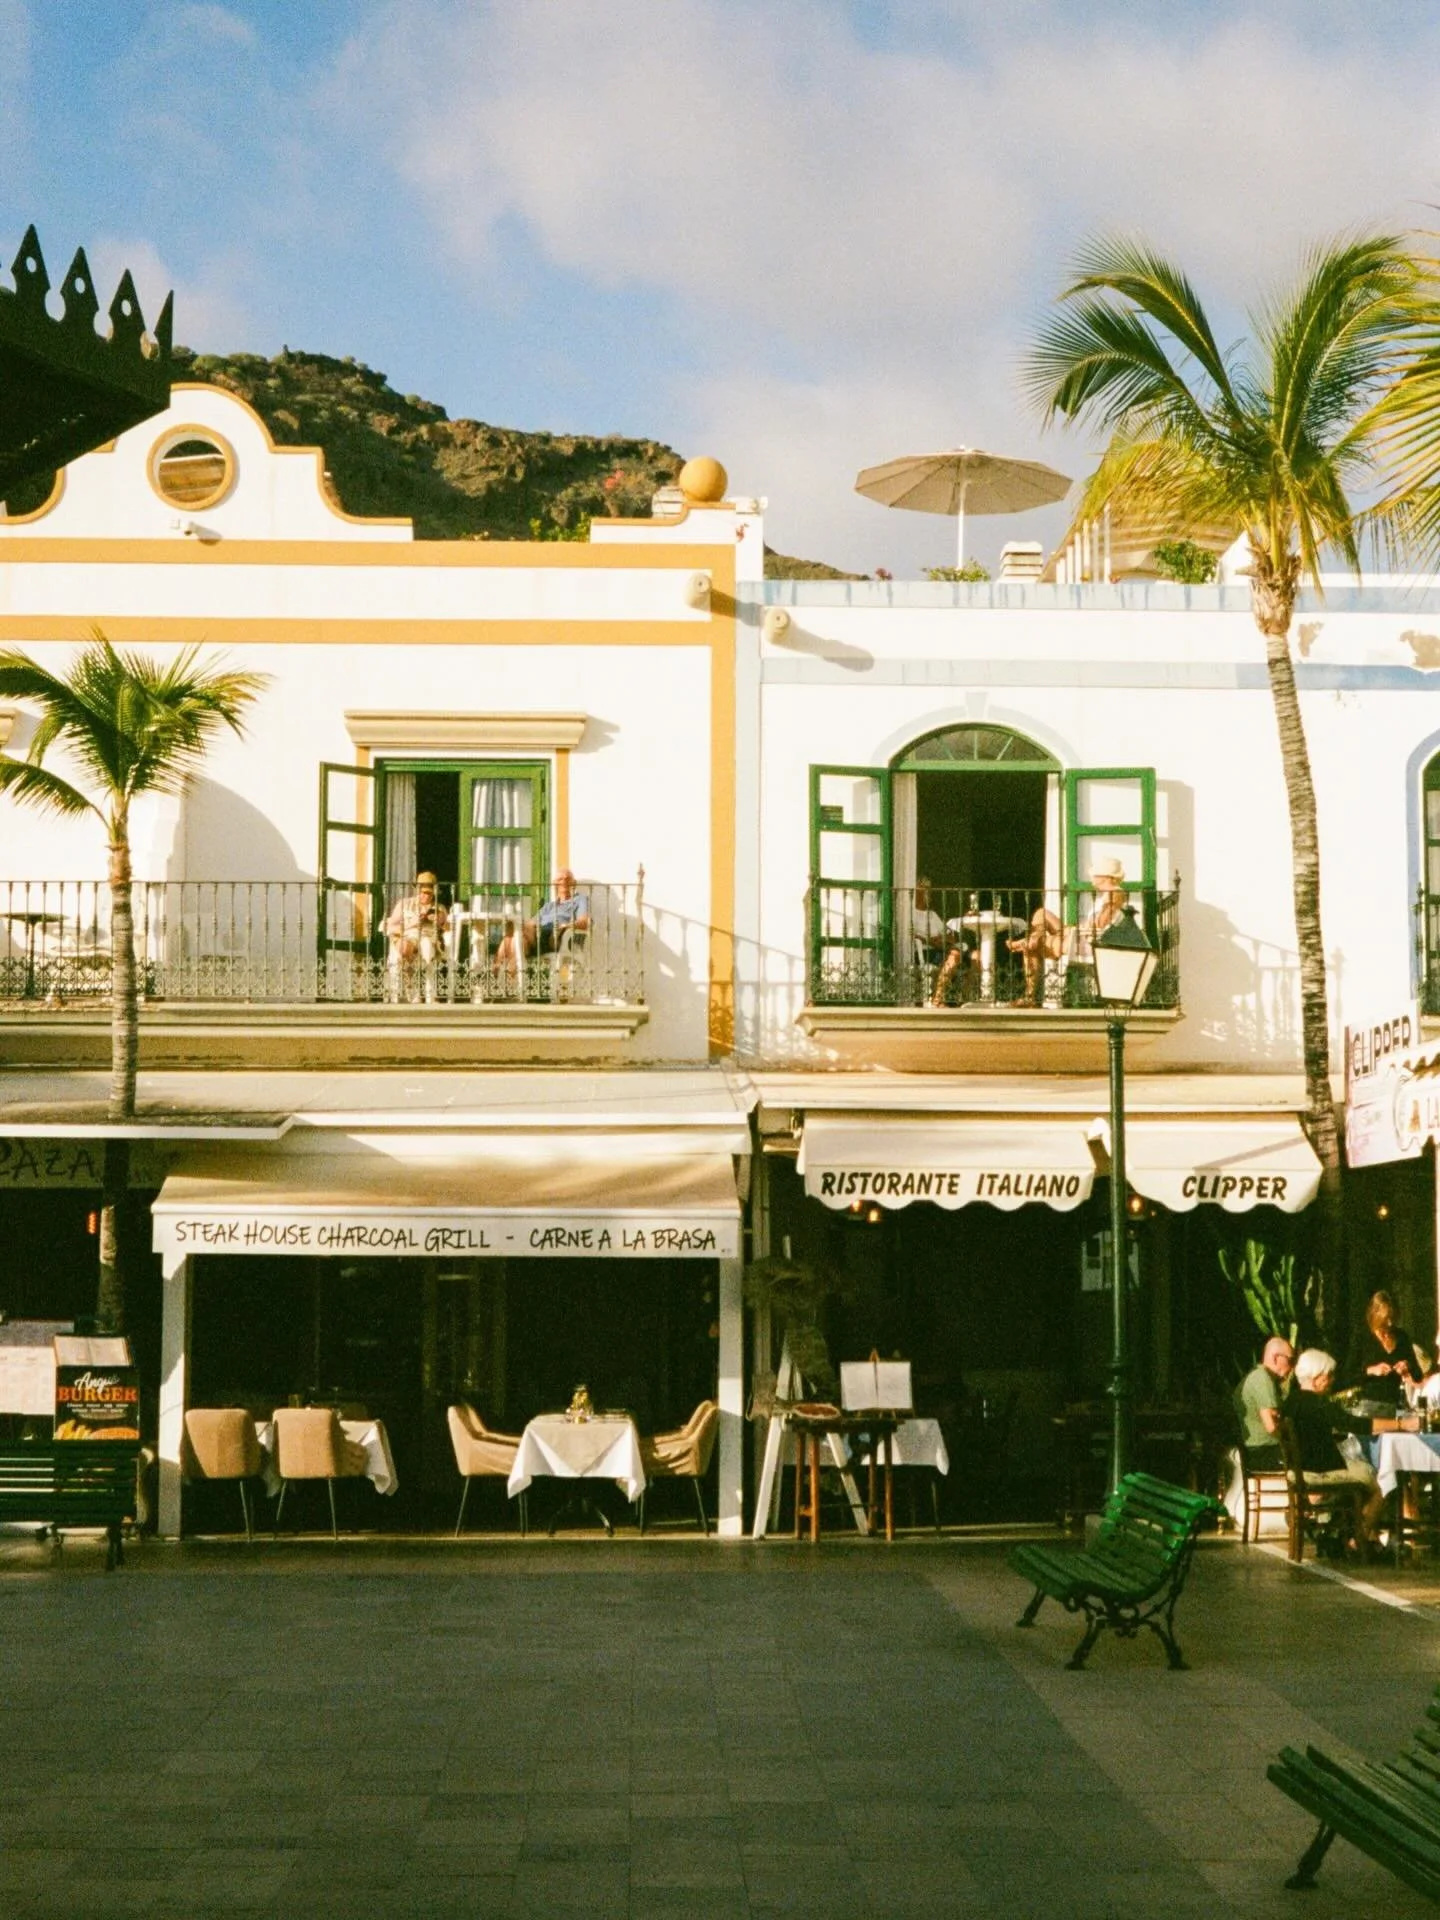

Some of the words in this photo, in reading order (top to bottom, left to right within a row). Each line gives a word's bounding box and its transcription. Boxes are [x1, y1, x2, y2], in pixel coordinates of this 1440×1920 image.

[821, 1171, 961, 1197] RISTORANTE
[975, 1172, 1081, 1198] ITALIANO
[1181, 1174, 1289, 1200] CLIPPER
[175, 1220, 240, 1243] STEAK
[243, 1219, 312, 1246] HOUSE
[317, 1222, 419, 1249] CHARCOAL
[424, 1227, 491, 1252] GRILL
[529, 1227, 593, 1250] CARNE
[598, 1228, 612, 1250] A
[622, 1229, 646, 1251] LA
[651, 1227, 717, 1251] BRASA
[57, 1386, 138, 1403] BURGER
